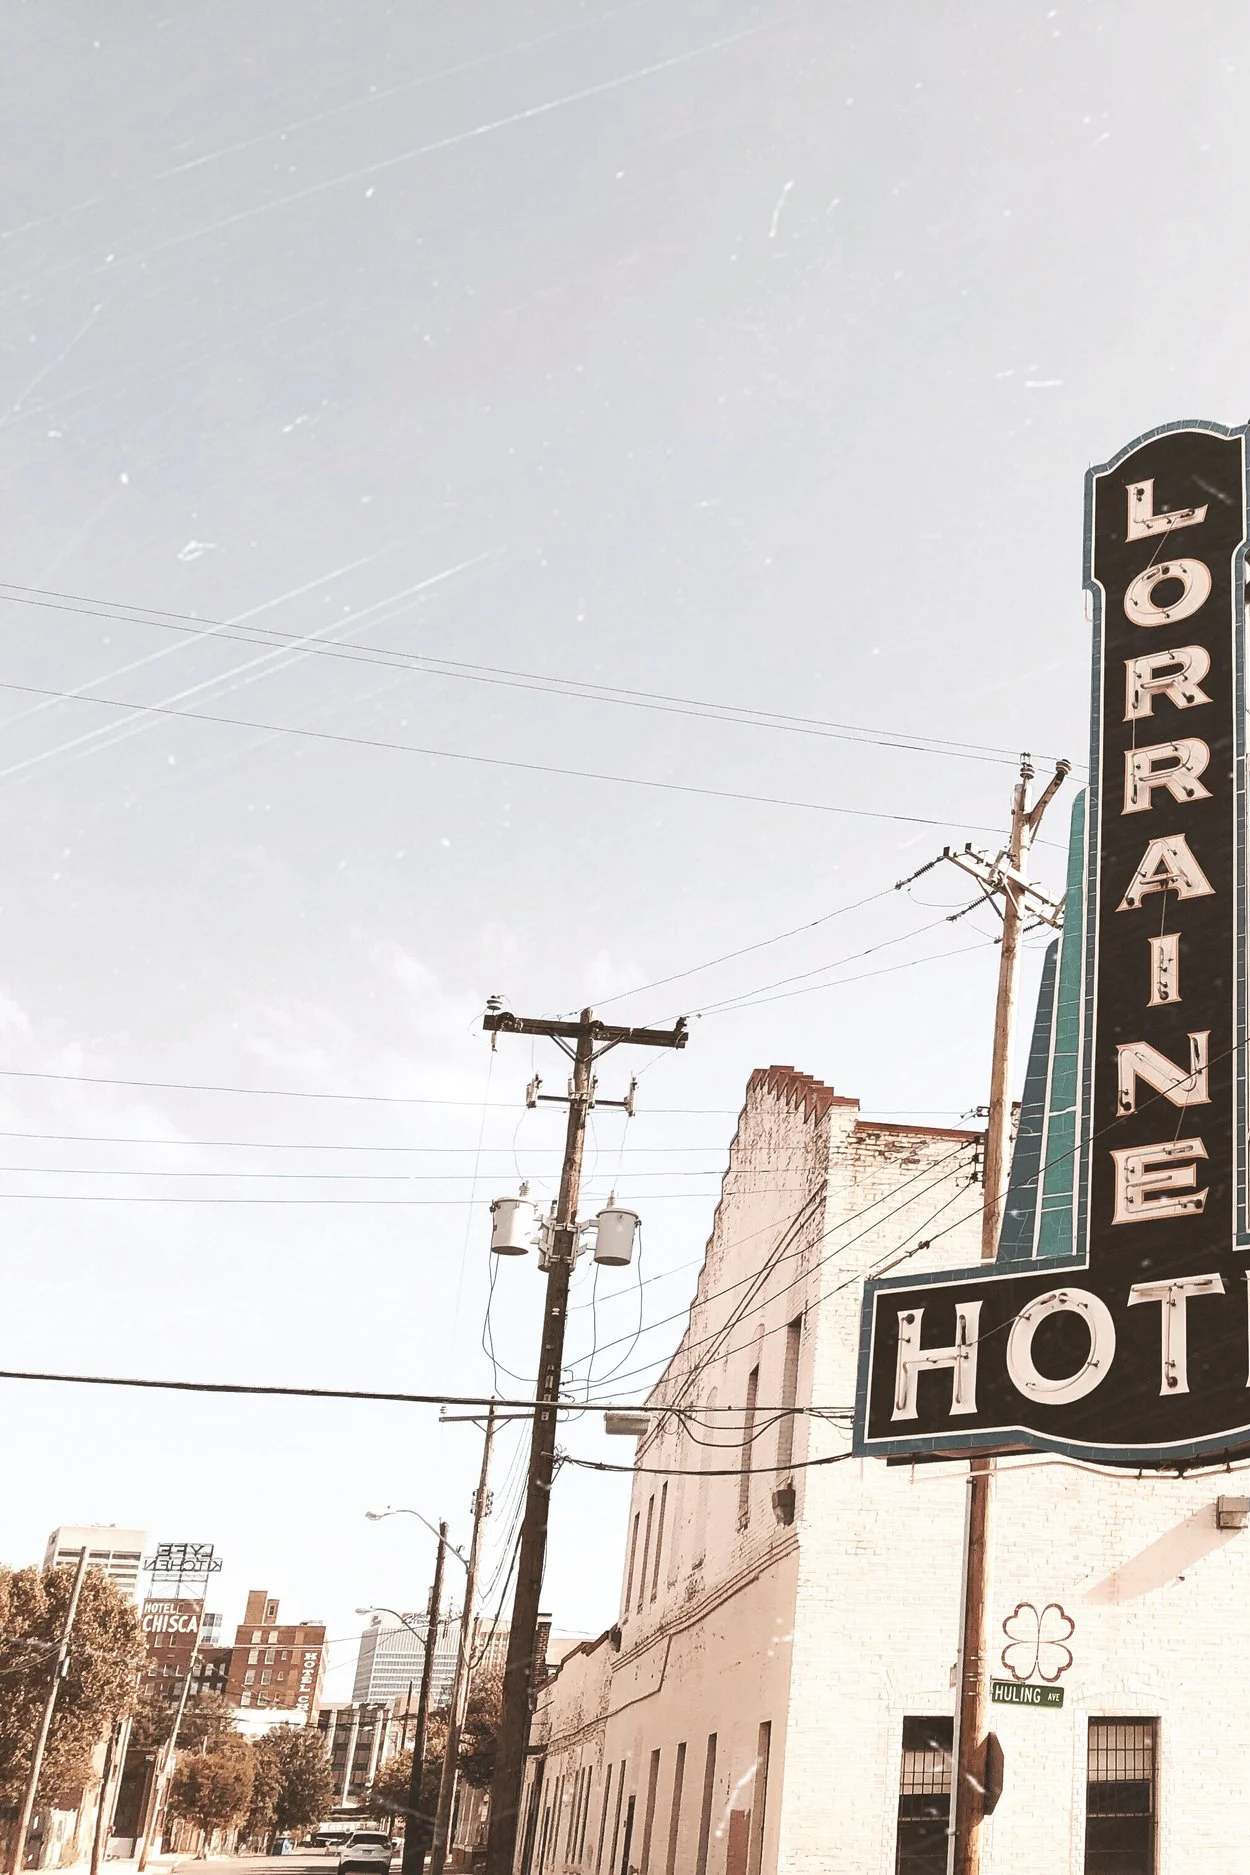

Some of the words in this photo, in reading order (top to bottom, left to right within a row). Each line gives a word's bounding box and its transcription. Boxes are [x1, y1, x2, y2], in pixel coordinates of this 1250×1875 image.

[1110, 478, 1215, 1227] LORRAINE
[144, 1602, 177, 1614] HOTEL
[142, 1615, 198, 1633] CHISCA
[299, 1652, 318, 1692] HOTEL
[995, 1685, 1041, 1703] HULING
[1048, 1692, 1060, 1702] AVE
